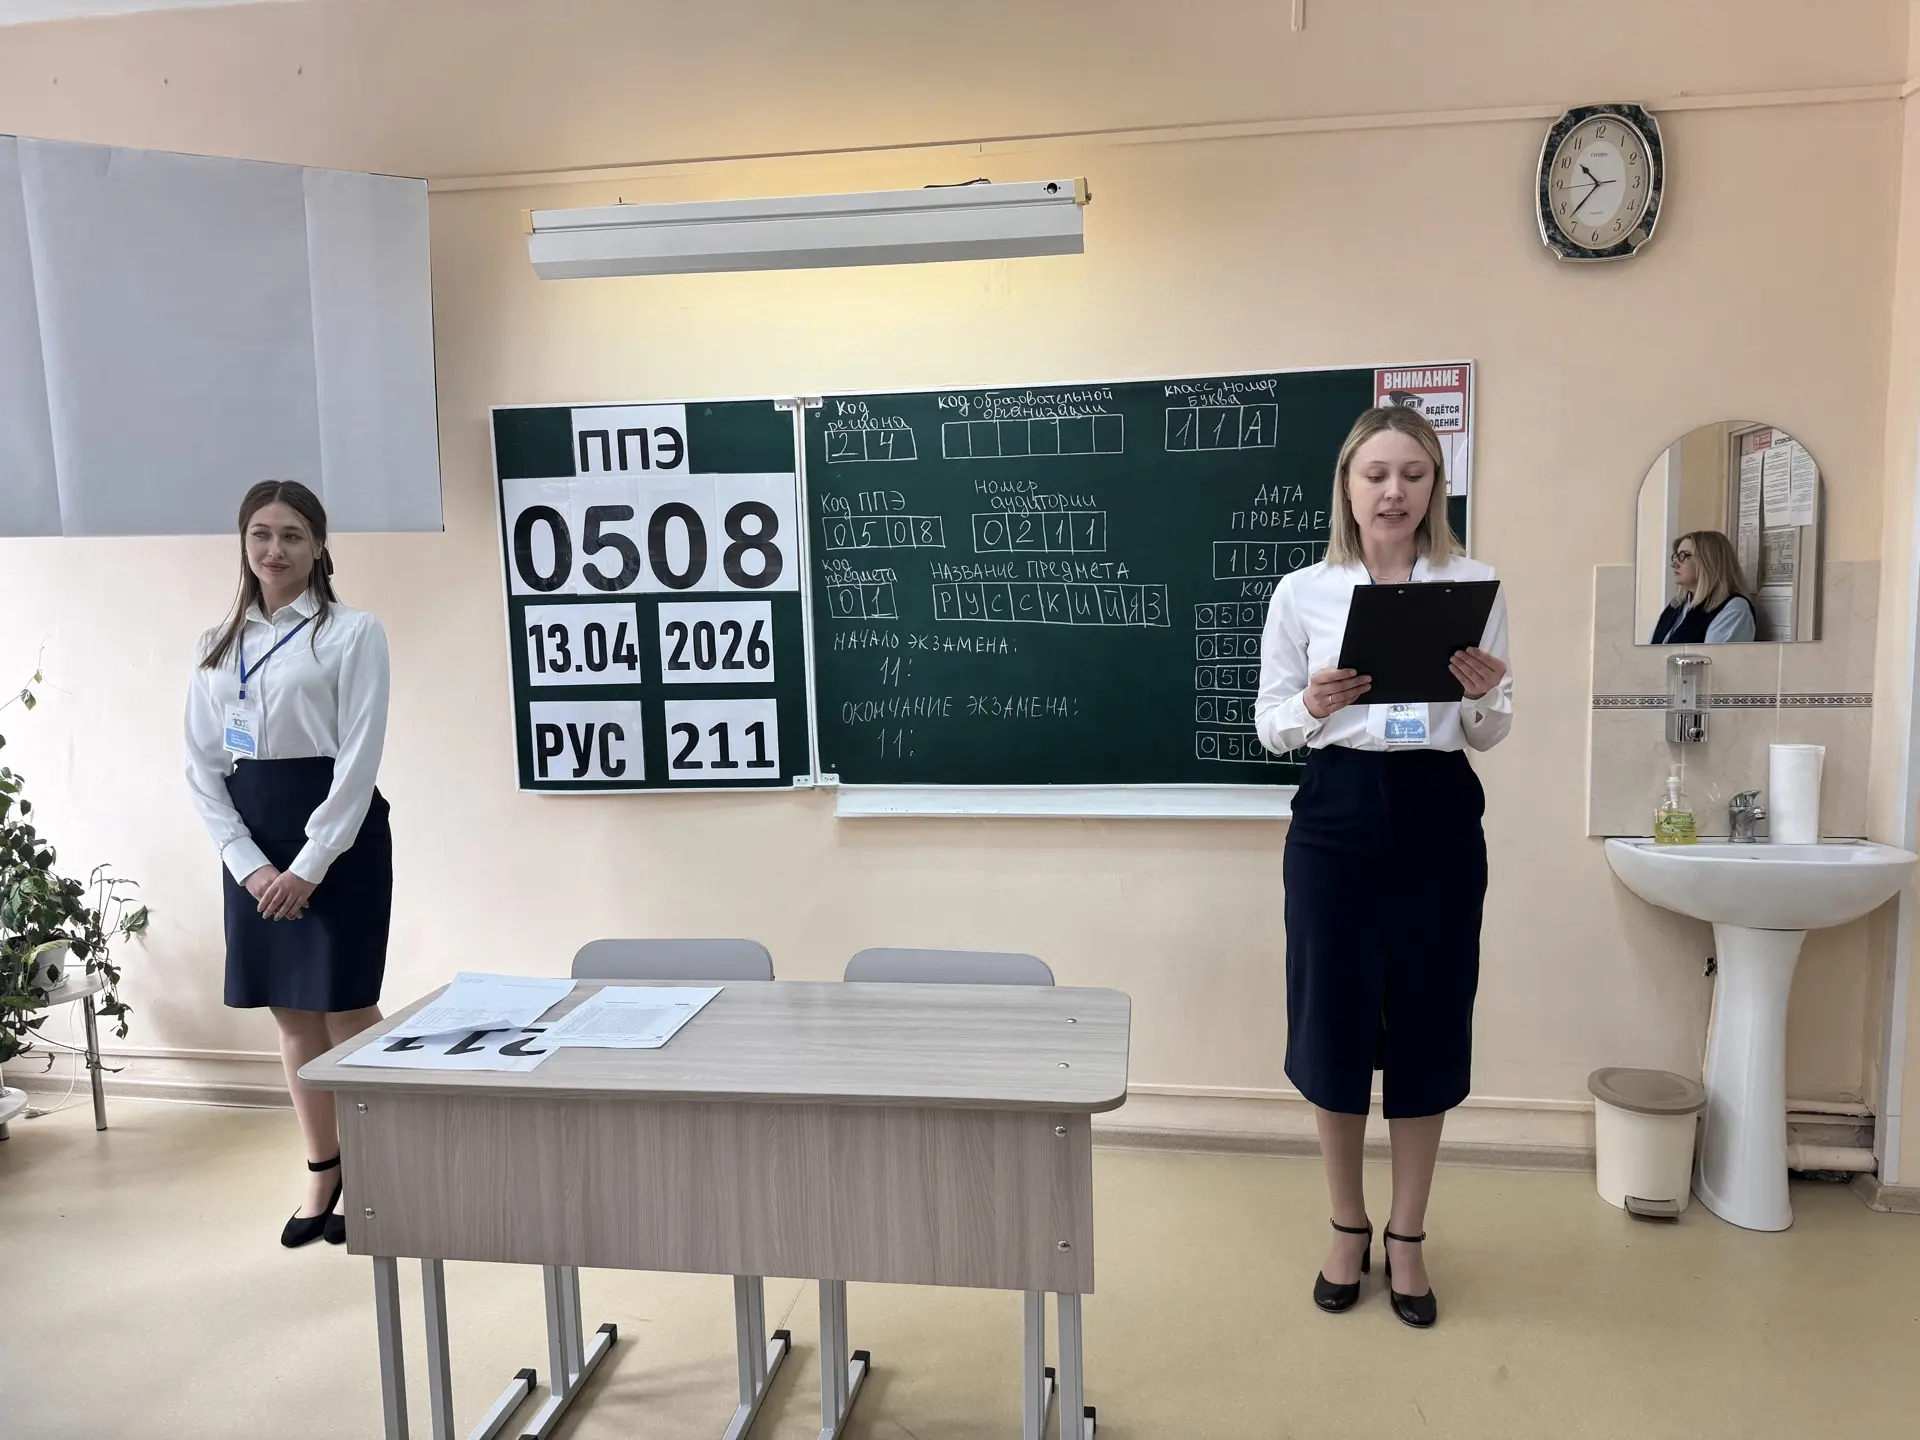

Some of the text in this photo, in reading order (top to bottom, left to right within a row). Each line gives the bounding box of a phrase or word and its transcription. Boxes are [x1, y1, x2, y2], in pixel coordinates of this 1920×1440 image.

[1595, 125, 1606, 138] 12
[1620, 135, 1625, 147] 1
[1573, 137, 1582, 150] 11
[1560, 156, 1571, 169] 10
[1629, 152, 1637, 165] 2
[1556, 180, 1564, 190] 9
[1632, 176, 1640, 189] 3
[1559, 202, 1567, 215] 8
[1627, 199, 1635, 211] 4
[1570, 221, 1578, 234] 7
[1592, 228, 1598, 242] 6
[1613, 218, 1622, 232] 5
[1383, 369, 1460, 389] ВНИМАНИЕ
[1425, 404, 1460, 416] ВЕДЁТСЯ
[578, 426, 684, 472] ППЭ
[831, 431, 894, 460] 24
[858, 490, 906, 512] ППЭ
[1254, 483, 1304, 507] ДАТА
[983, 518, 1095, 545] 0211
[1231, 509, 1332, 533] ПРОВЕДЕ
[834, 520, 933, 548] 0508
[513, 500, 784, 592] 0508
[1229, 547, 1327, 572] 130
[839, 586, 893, 617] 01
[528, 621, 638, 674] 13.04
[665, 619, 770, 671] 2026
[834, 628, 1018, 654] НАЧАЛО ЭКЗАМЕНА:
[842, 694, 1079, 726] ОКОНЧАНИЕ ЭКЗАМЕНА:
[535, 722, 627, 778] РУС
[670, 721, 775, 770] 211
